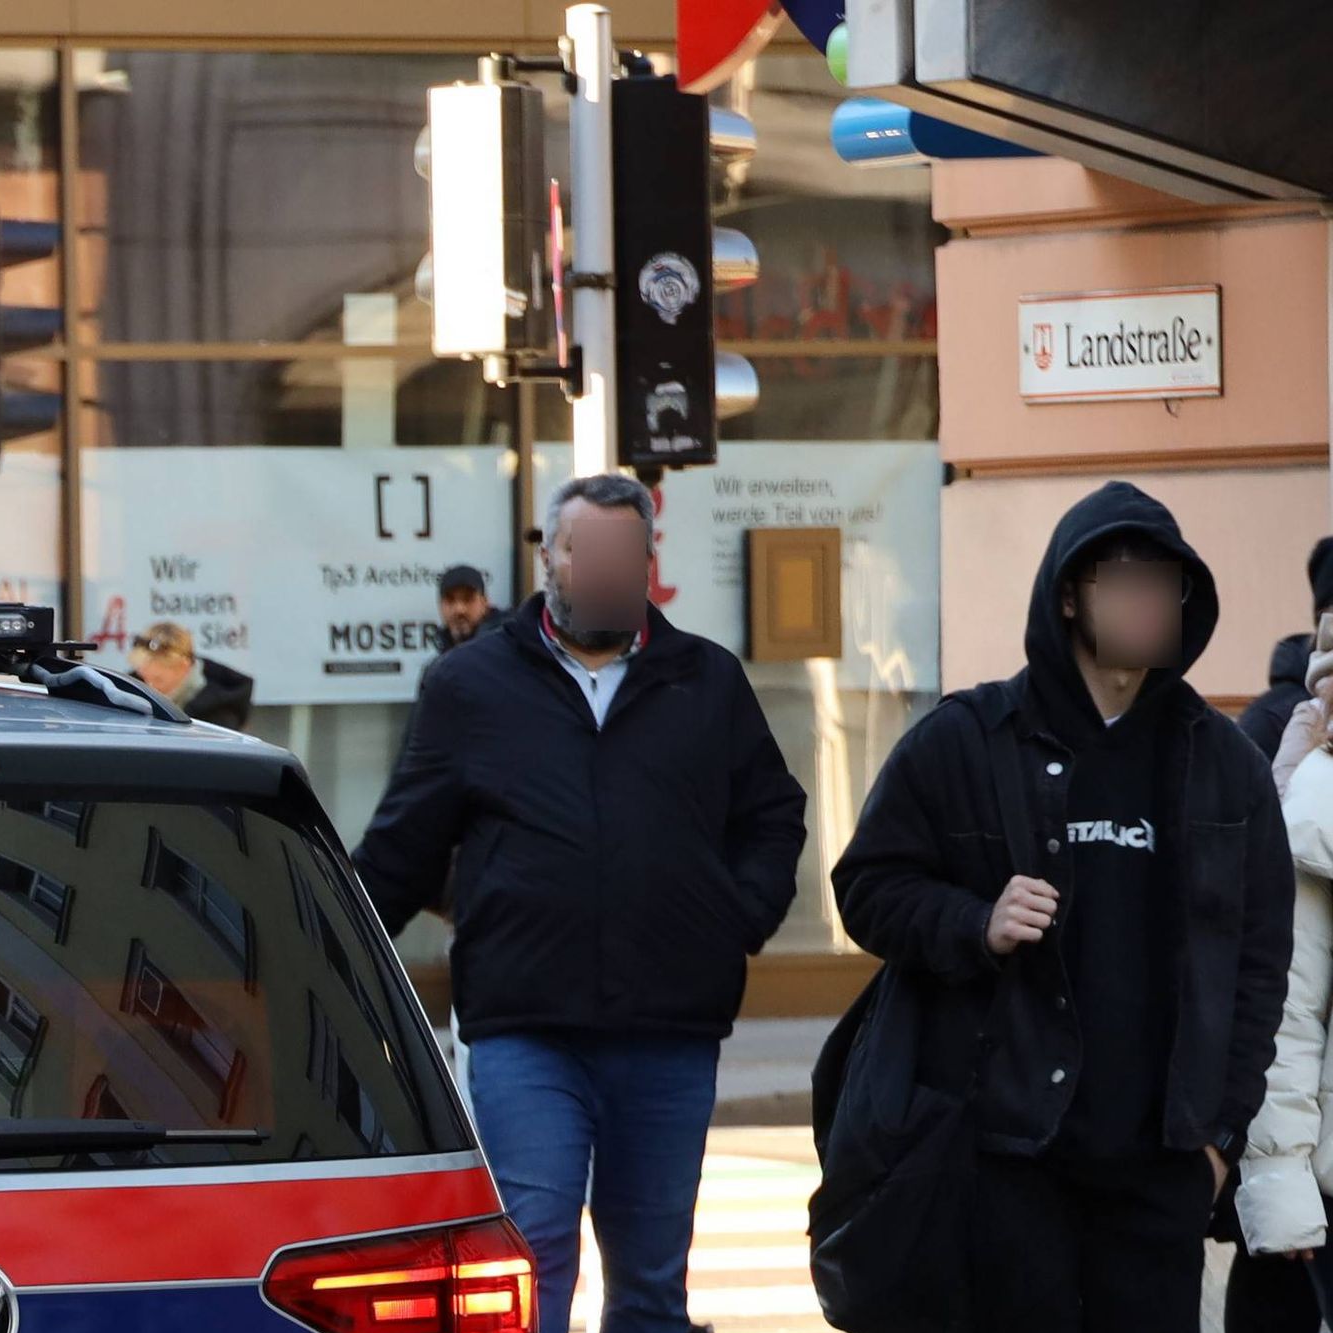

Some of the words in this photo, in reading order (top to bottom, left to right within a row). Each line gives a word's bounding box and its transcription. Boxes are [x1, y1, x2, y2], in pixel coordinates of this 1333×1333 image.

[1065, 316, 1201, 368] Landstraße
[150, 556, 199, 580] Wir
[150, 589, 236, 616] bauen
[330, 621, 441, 652] MOSER
